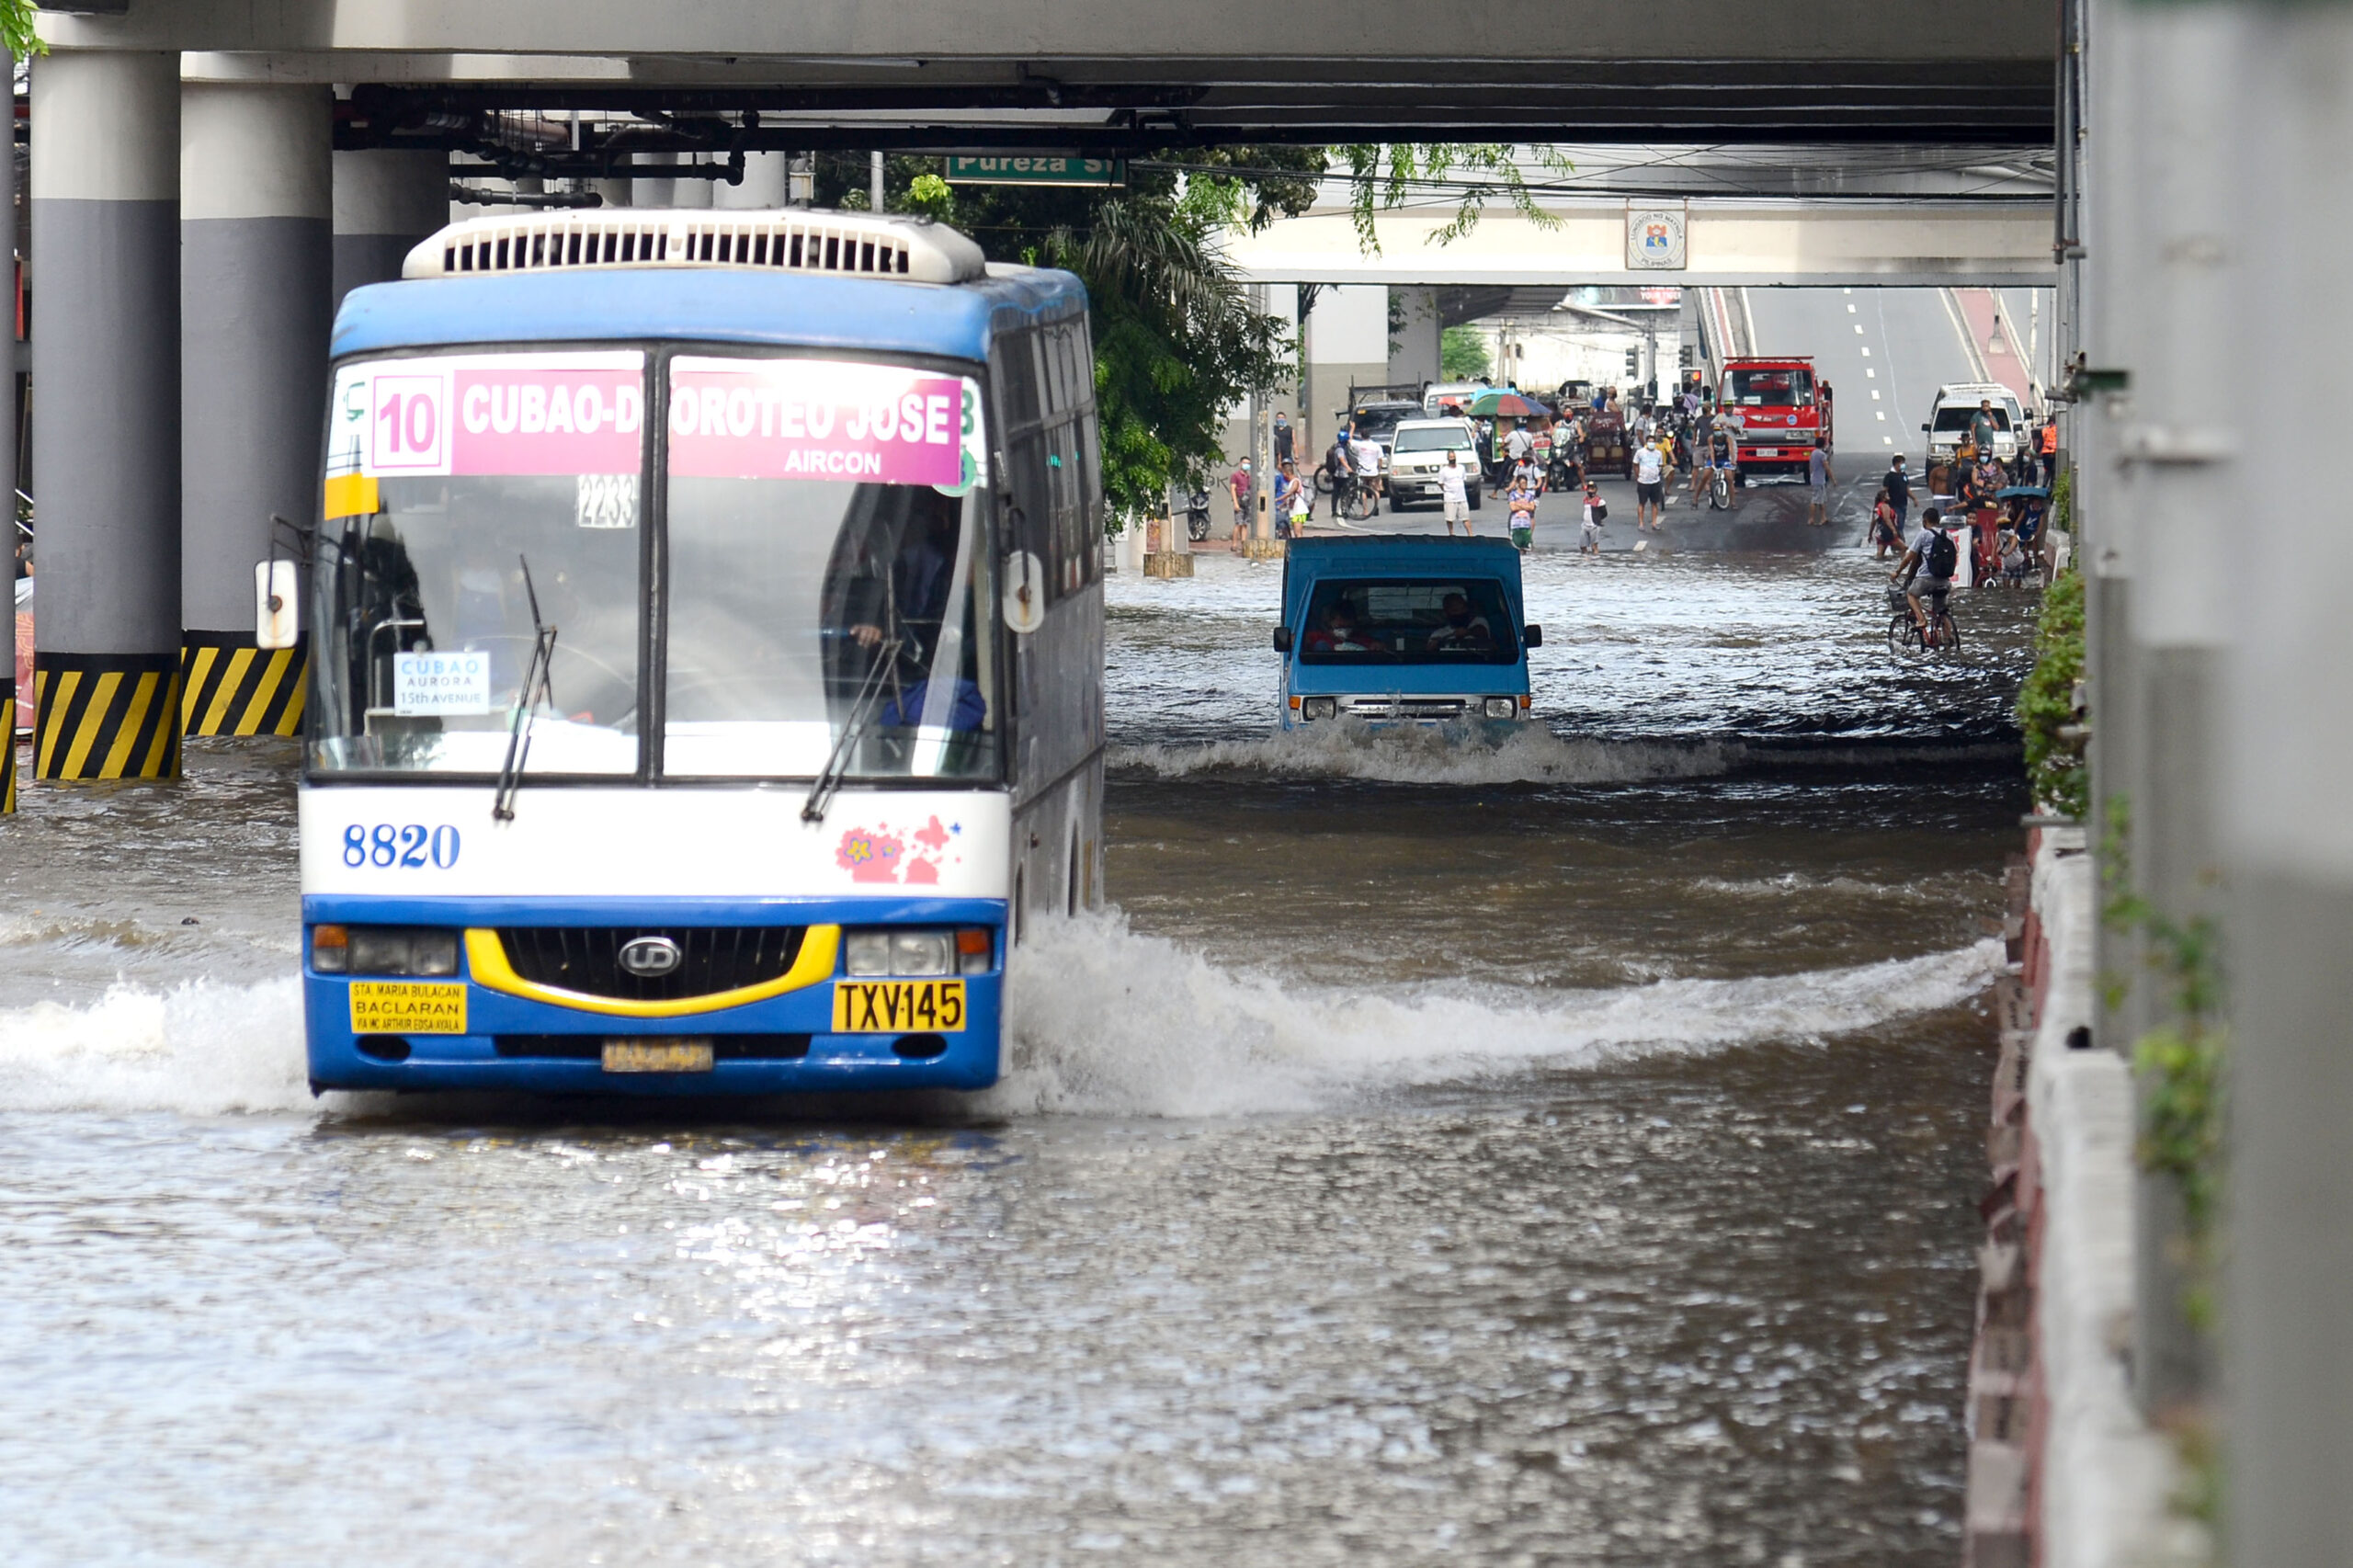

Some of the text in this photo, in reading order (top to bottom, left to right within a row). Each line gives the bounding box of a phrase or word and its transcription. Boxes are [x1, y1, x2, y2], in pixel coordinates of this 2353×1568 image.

[958, 157, 1066, 172] Pureza
[380, 392, 436, 453] 10
[846, 393, 949, 445] JOSE
[784, 449, 881, 475] AIRCON
[581, 475, 633, 527] 2233
[402, 660, 479, 675] CUBAO
[407, 676, 472, 687] AURORA
[401, 692, 482, 705] 15th AVENUE
[343, 824, 460, 869] 8820
[377, 984, 408, 997] MARIA
[411, 985, 460, 999] BULACAN
[355, 1001, 460, 1016] BACLARAN
[357, 1017, 368, 1029] VIA
[382, 1018, 412, 1030] ARTHUR
[414, 1019, 434, 1031] EDSA
[436, 1019, 460, 1032] AYALA
